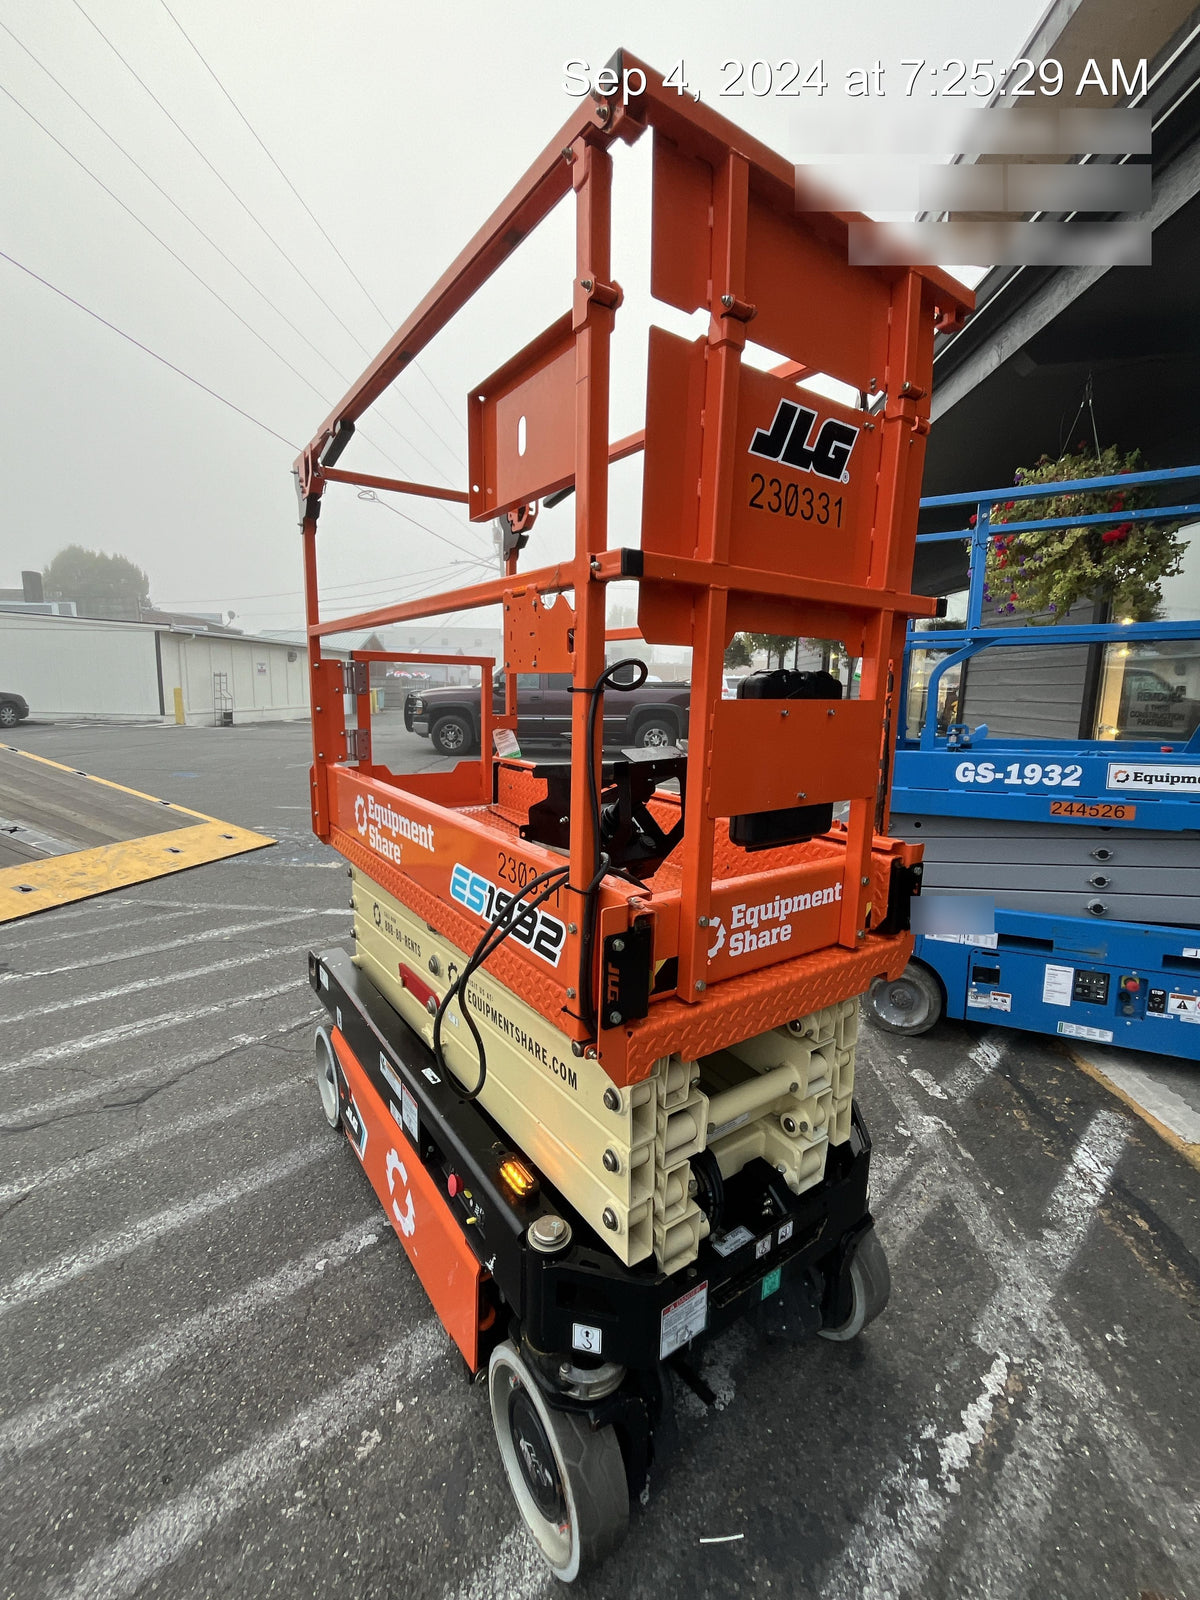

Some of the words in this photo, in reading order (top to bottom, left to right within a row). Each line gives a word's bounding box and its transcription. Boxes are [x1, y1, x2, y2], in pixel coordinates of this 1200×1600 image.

[749, 472, 843, 528] 230331
[955, 761, 1083, 787] GS-1932
[1133, 771, 1200, 786] Equipm
[367, 794, 435, 853] Equipment
[1051, 801, 1126, 819] 244526
[368, 823, 402, 865] Share
[450, 863, 566, 968] ES1932
[731, 882, 843, 930] Equipment
[729, 924, 792, 957] Share
[467, 989, 578, 1091] EQUIPMENTSHARE.COM
